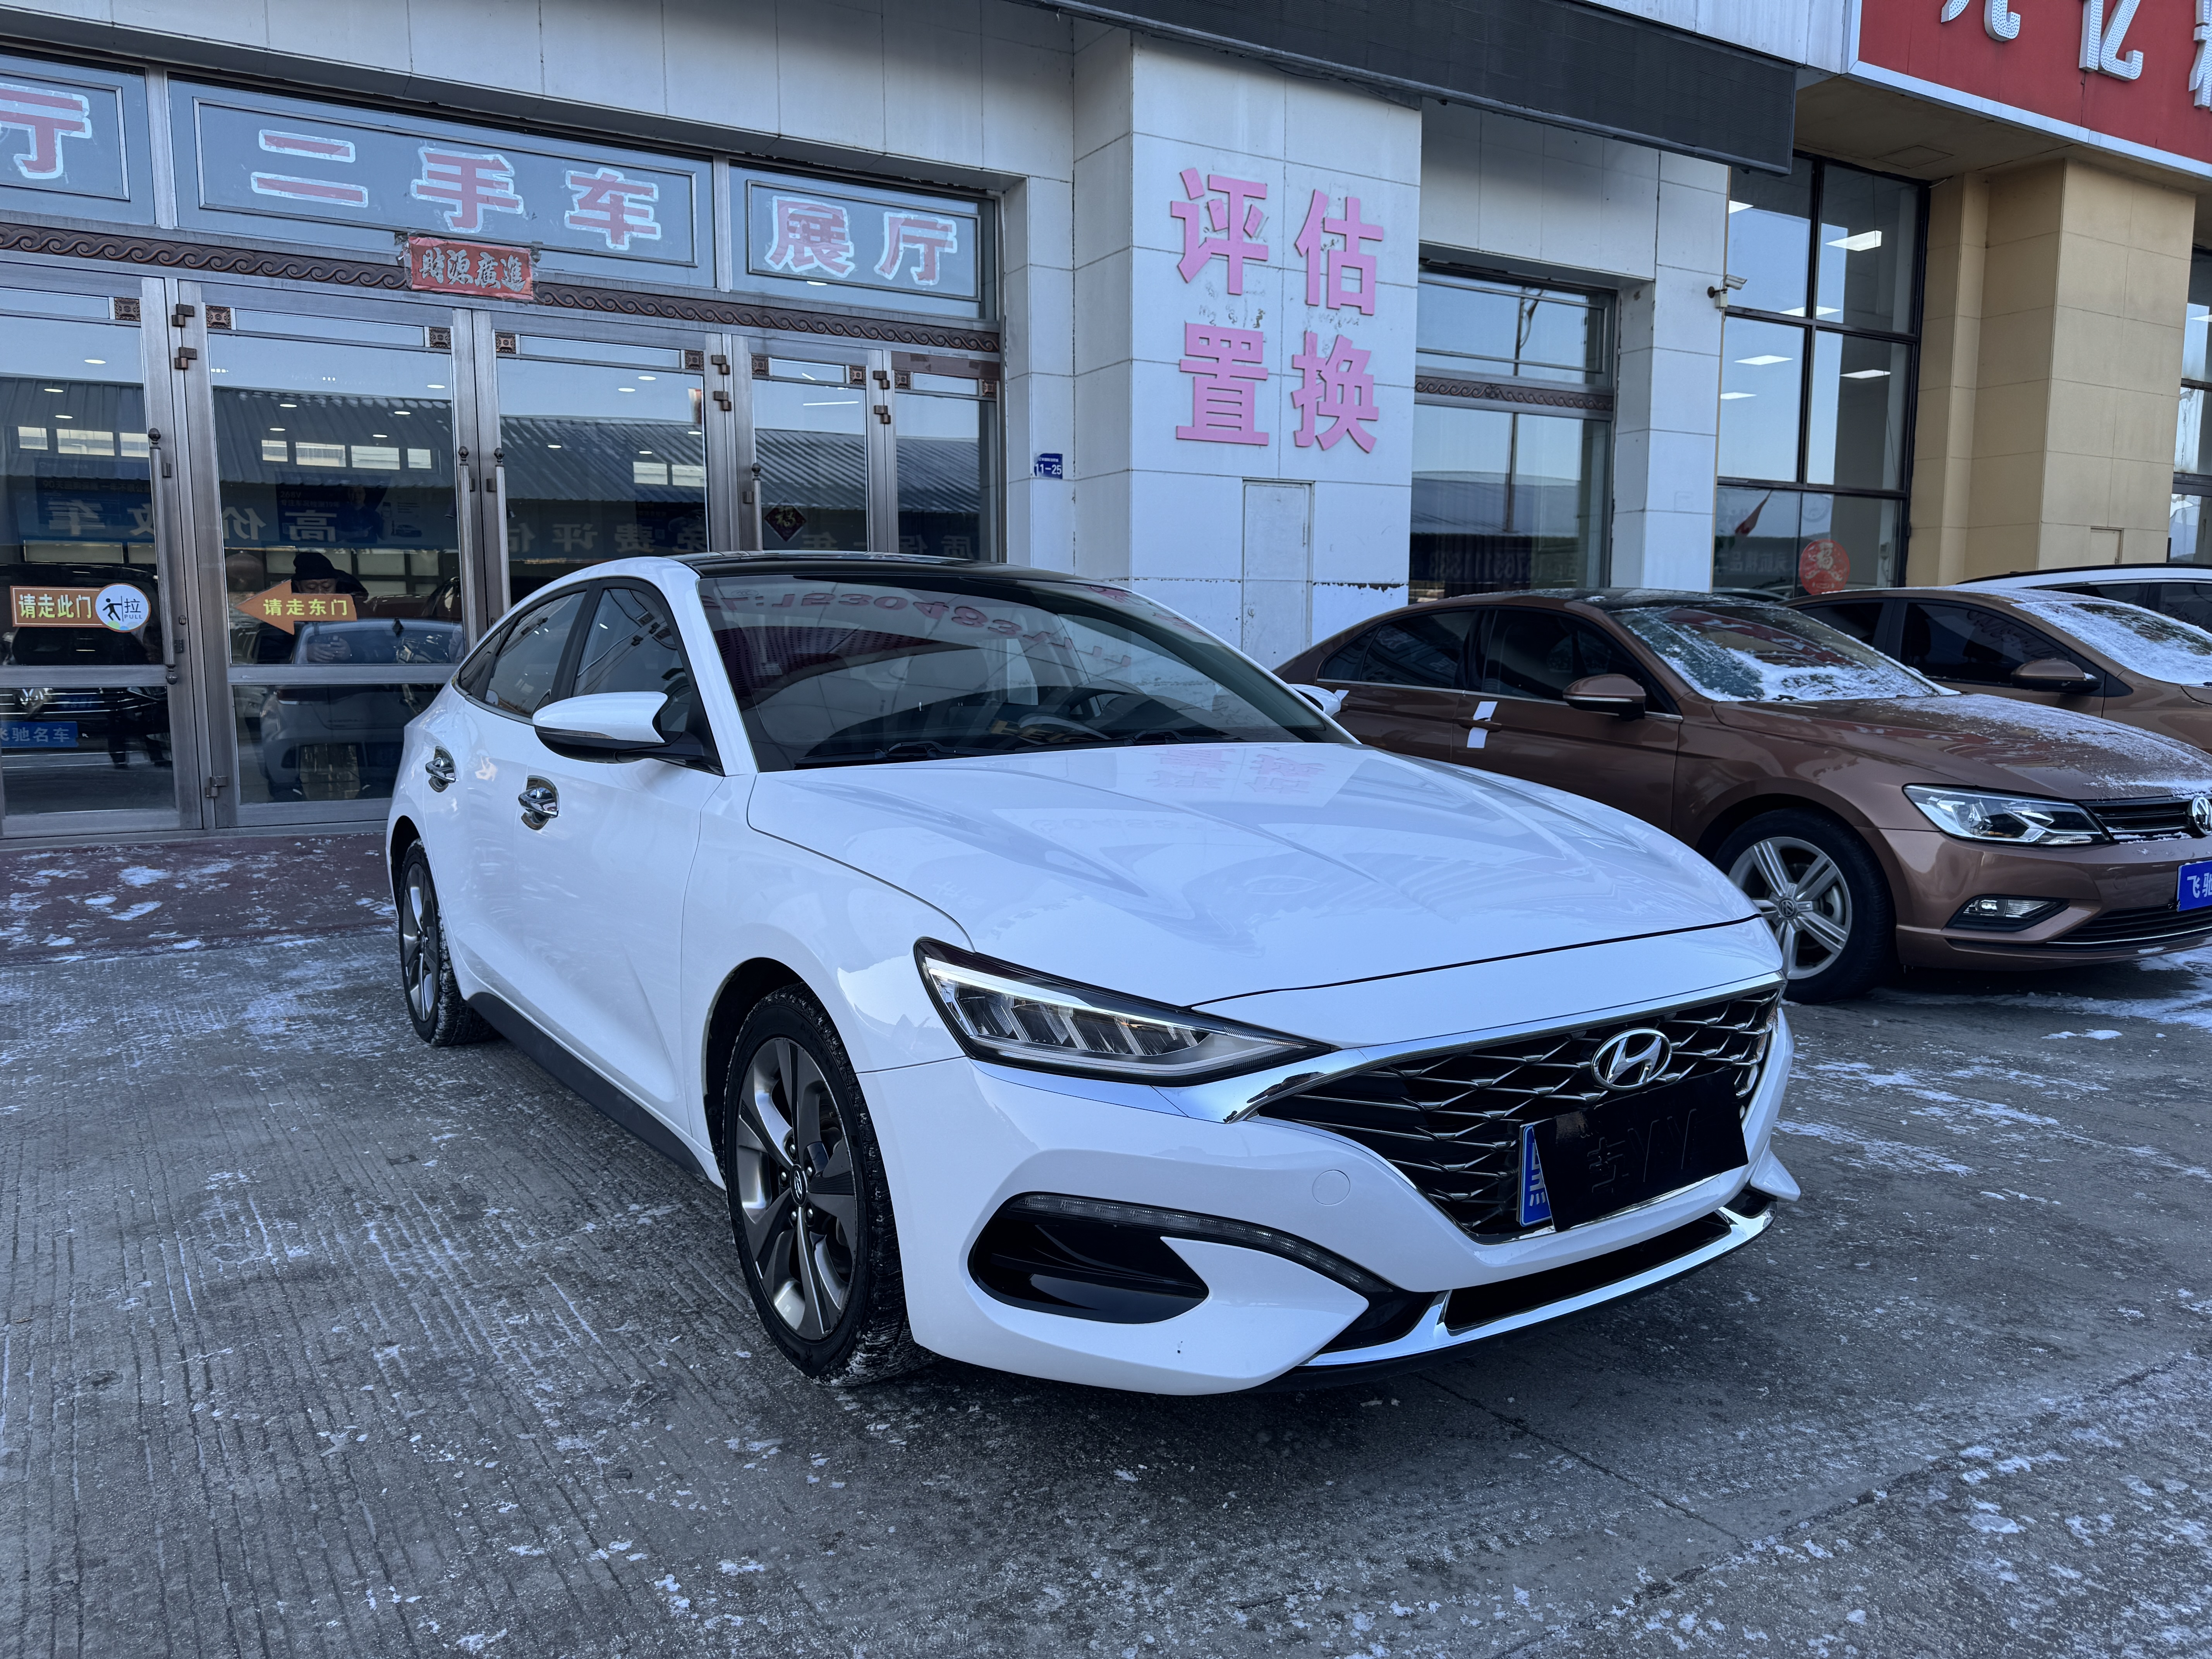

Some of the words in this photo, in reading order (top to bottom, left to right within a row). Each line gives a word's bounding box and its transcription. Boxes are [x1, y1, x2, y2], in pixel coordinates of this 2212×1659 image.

[764, 195, 958, 286] 展厅
[1171, 168, 1384, 316] 评估
[1176, 323, 1379, 453] 置换
[1035, 463, 1062, 476] 11-25
[280, 491, 302, 499] 268V
[19, 594, 91, 619] 请走此门
[124, 598, 141, 613] 拉
[263, 599, 348, 616] 请走东门
